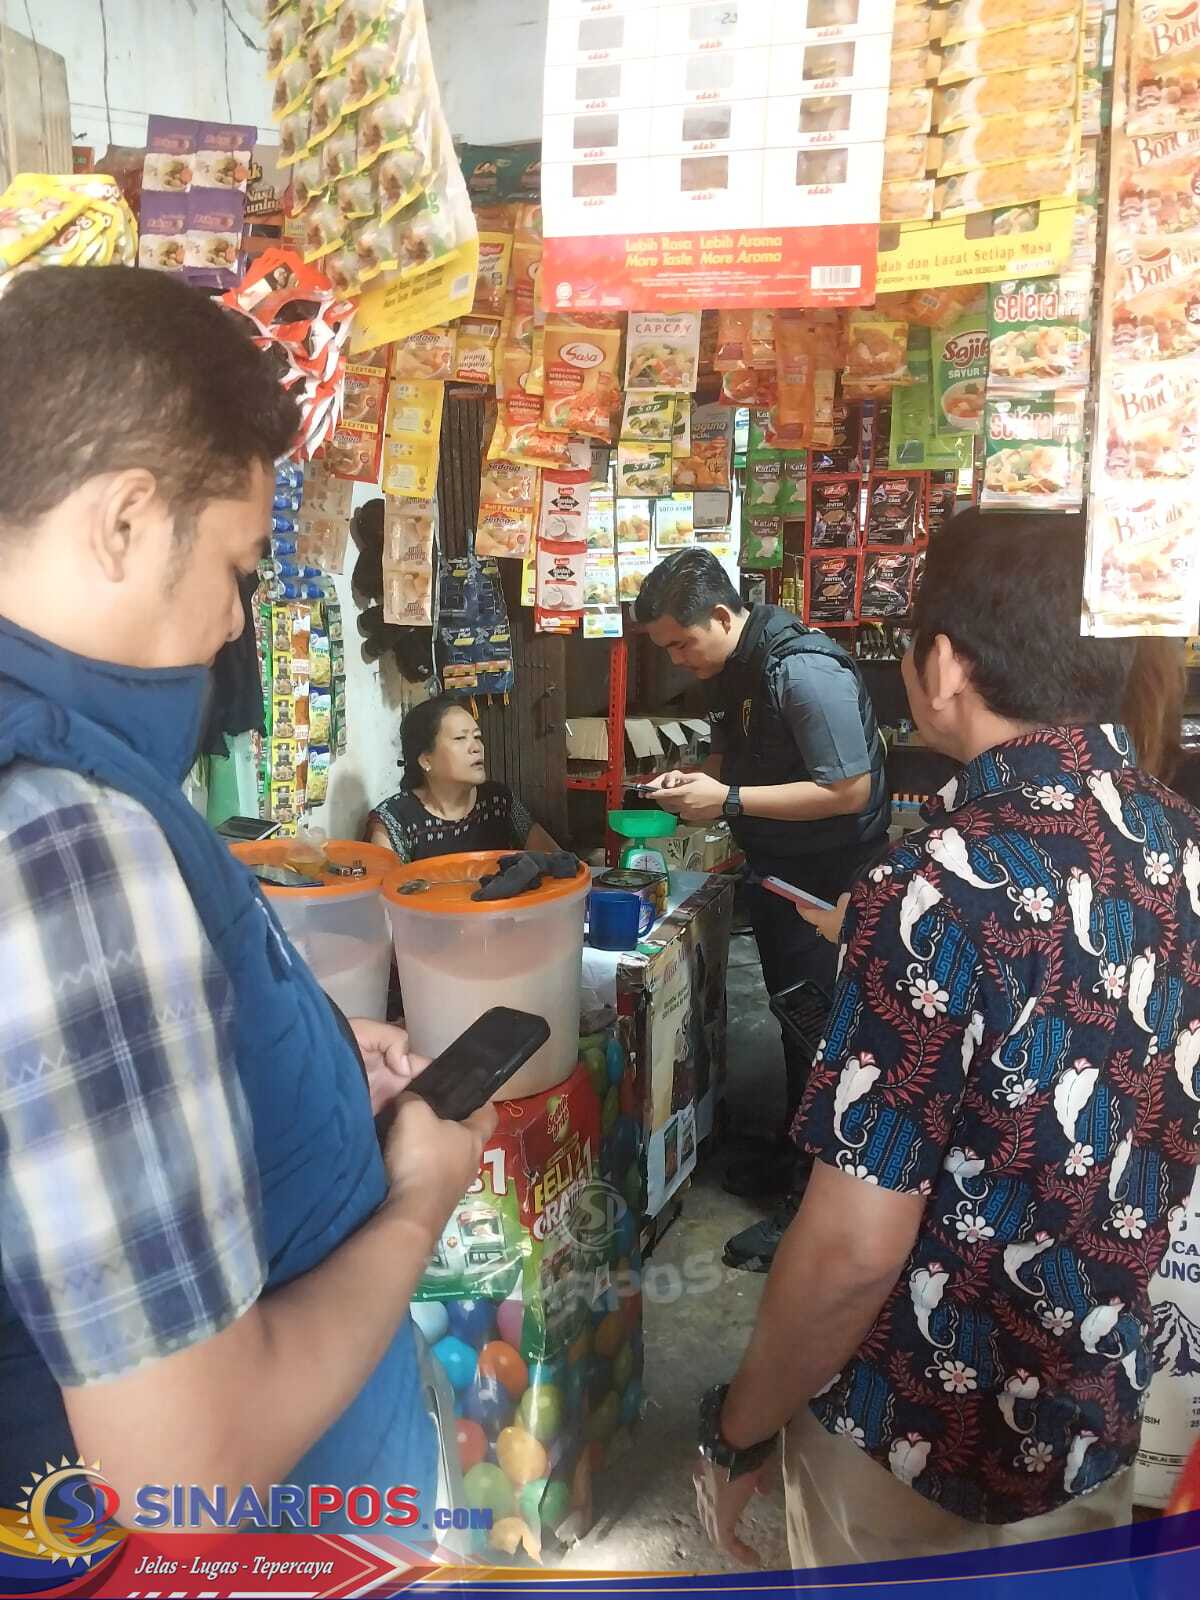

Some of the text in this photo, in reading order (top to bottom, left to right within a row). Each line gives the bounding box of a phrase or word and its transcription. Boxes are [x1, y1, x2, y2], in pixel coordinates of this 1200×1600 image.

[737, 231, 782, 248] Aroma
[736, 248, 781, 264] Aroma
[993, 292, 1058, 321] selera
[635, 323, 693, 334] CAPCAY
[947, 367, 980, 379] SAYUR
